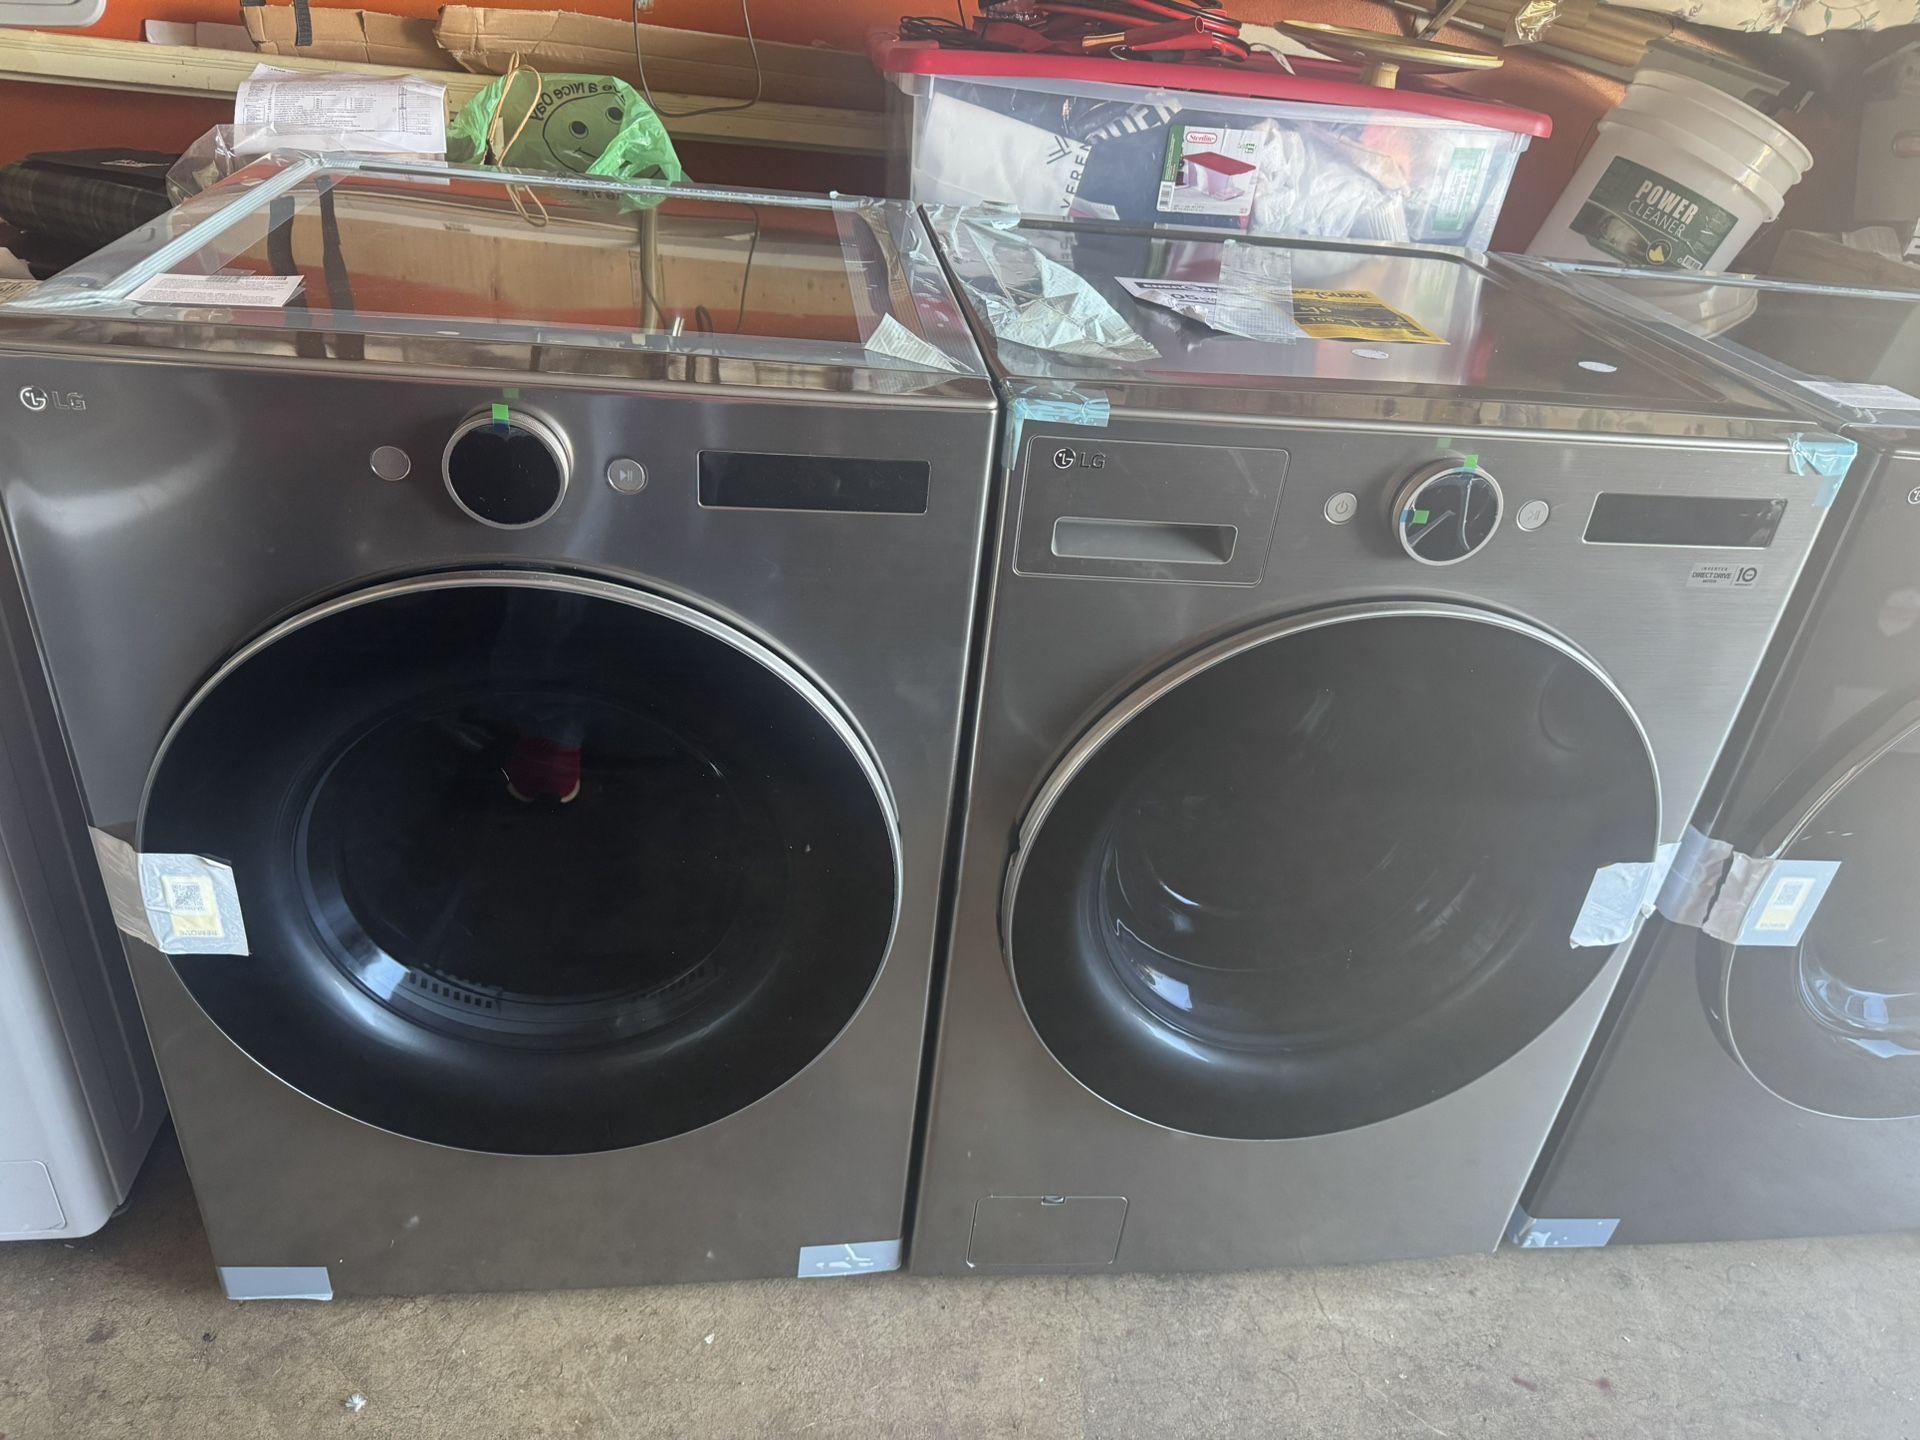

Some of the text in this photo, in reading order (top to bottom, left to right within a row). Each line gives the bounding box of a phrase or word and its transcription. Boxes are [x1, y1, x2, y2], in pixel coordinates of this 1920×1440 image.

[1627, 199, 1686, 238] CLEANER
[1635, 180, 1699, 225] POWER
[1080, 451, 1106, 469] LG
